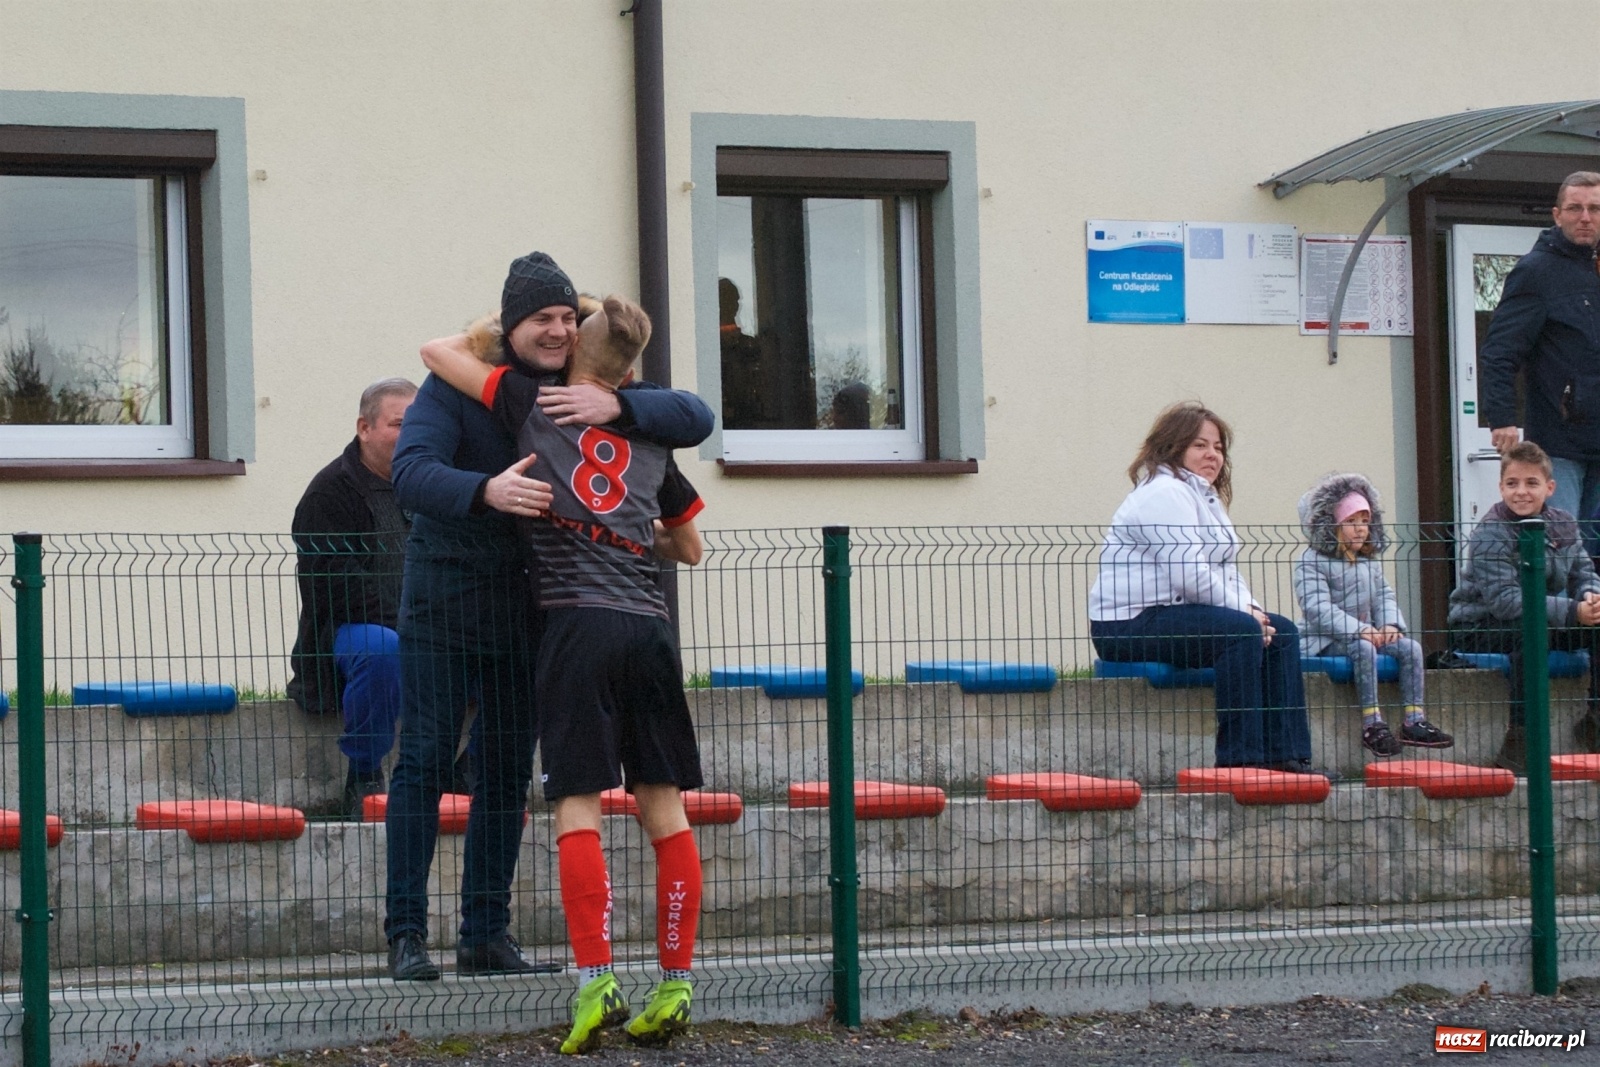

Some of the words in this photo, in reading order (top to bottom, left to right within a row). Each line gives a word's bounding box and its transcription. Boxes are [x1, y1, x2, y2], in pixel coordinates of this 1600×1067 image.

[1099, 270, 1130, 280] Centrum
[1112, 283, 1122, 291] na
[571, 426, 631, 514] 8
